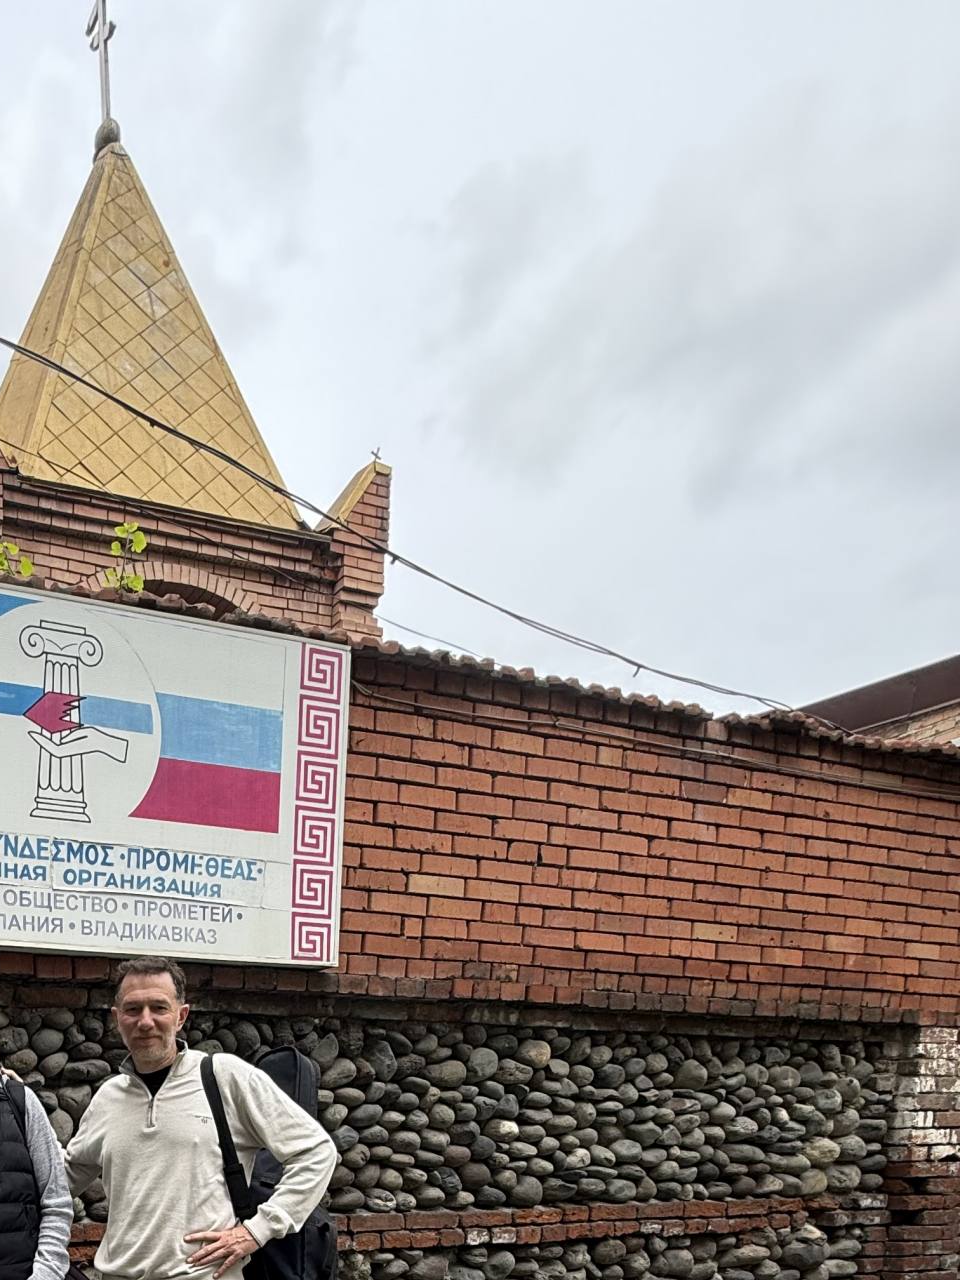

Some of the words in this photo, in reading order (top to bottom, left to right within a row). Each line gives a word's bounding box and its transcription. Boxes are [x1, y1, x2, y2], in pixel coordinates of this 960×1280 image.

[63, 868, 221, 898] ОРГАНИЗАЦИЯ
[3, 889, 118, 914] ОБЩЕСТВО
[134, 900, 233, 923] ПРОМЕТЕЙ
[81, 919, 217, 945] ВЛАДИКАВКАЗ
